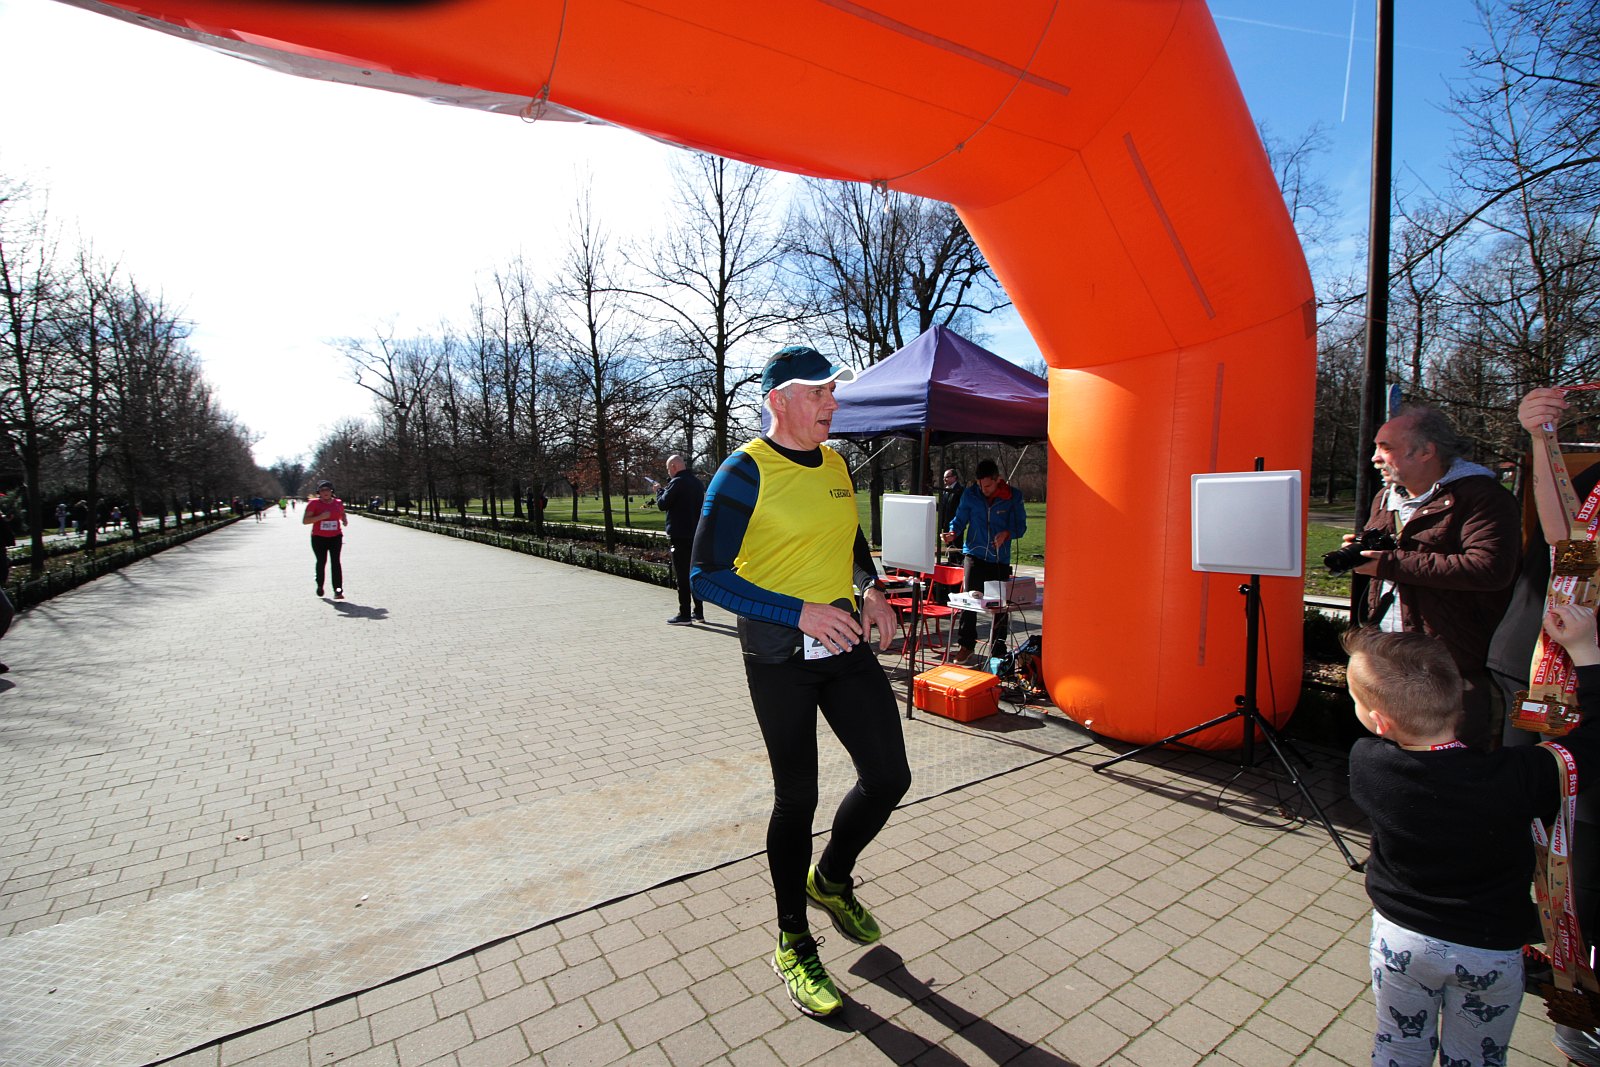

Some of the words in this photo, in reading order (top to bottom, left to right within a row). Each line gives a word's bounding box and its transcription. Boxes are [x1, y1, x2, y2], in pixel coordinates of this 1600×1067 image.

[1578, 496, 1598, 521] BIEG
[1535, 660, 1548, 683] BIEG
[1551, 743, 1576, 770] BIEG
[1569, 774, 1577, 793] Stu
